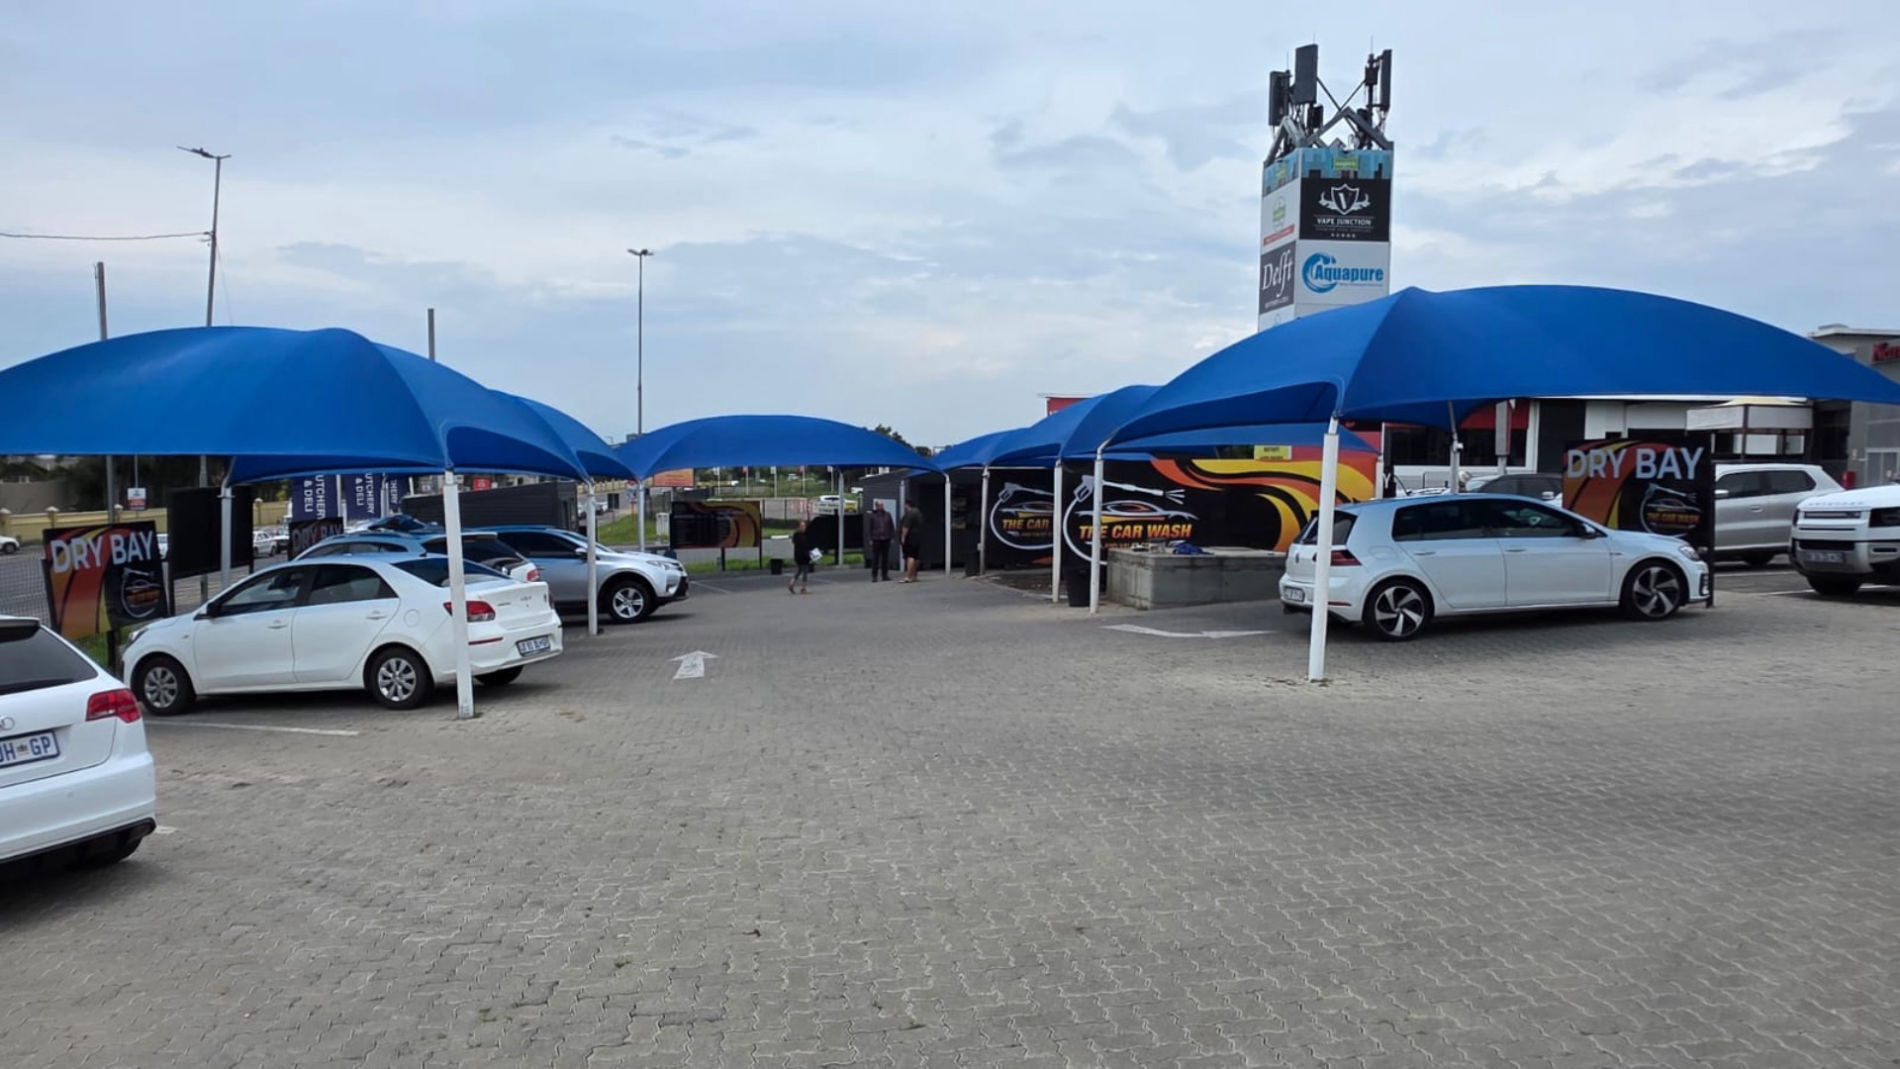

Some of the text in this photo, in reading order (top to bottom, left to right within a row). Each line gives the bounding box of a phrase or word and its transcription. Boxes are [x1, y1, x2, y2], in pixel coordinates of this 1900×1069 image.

[1317, 217, 1372, 226] VAPE JUNCTION
[1261, 250, 1293, 298] Delft
[1315, 264, 1384, 282] Aquapure
[1567, 447, 1704, 480] DRY BAY
[365, 473, 375, 514] UTCHERY
[1002, 519, 1024, 530] THE
[1111, 525, 1143, 538] CAR
[1147, 524, 1192, 538] WASH
[50, 531, 153, 573] DRY BAY
[29, 735, 51, 756] GP
